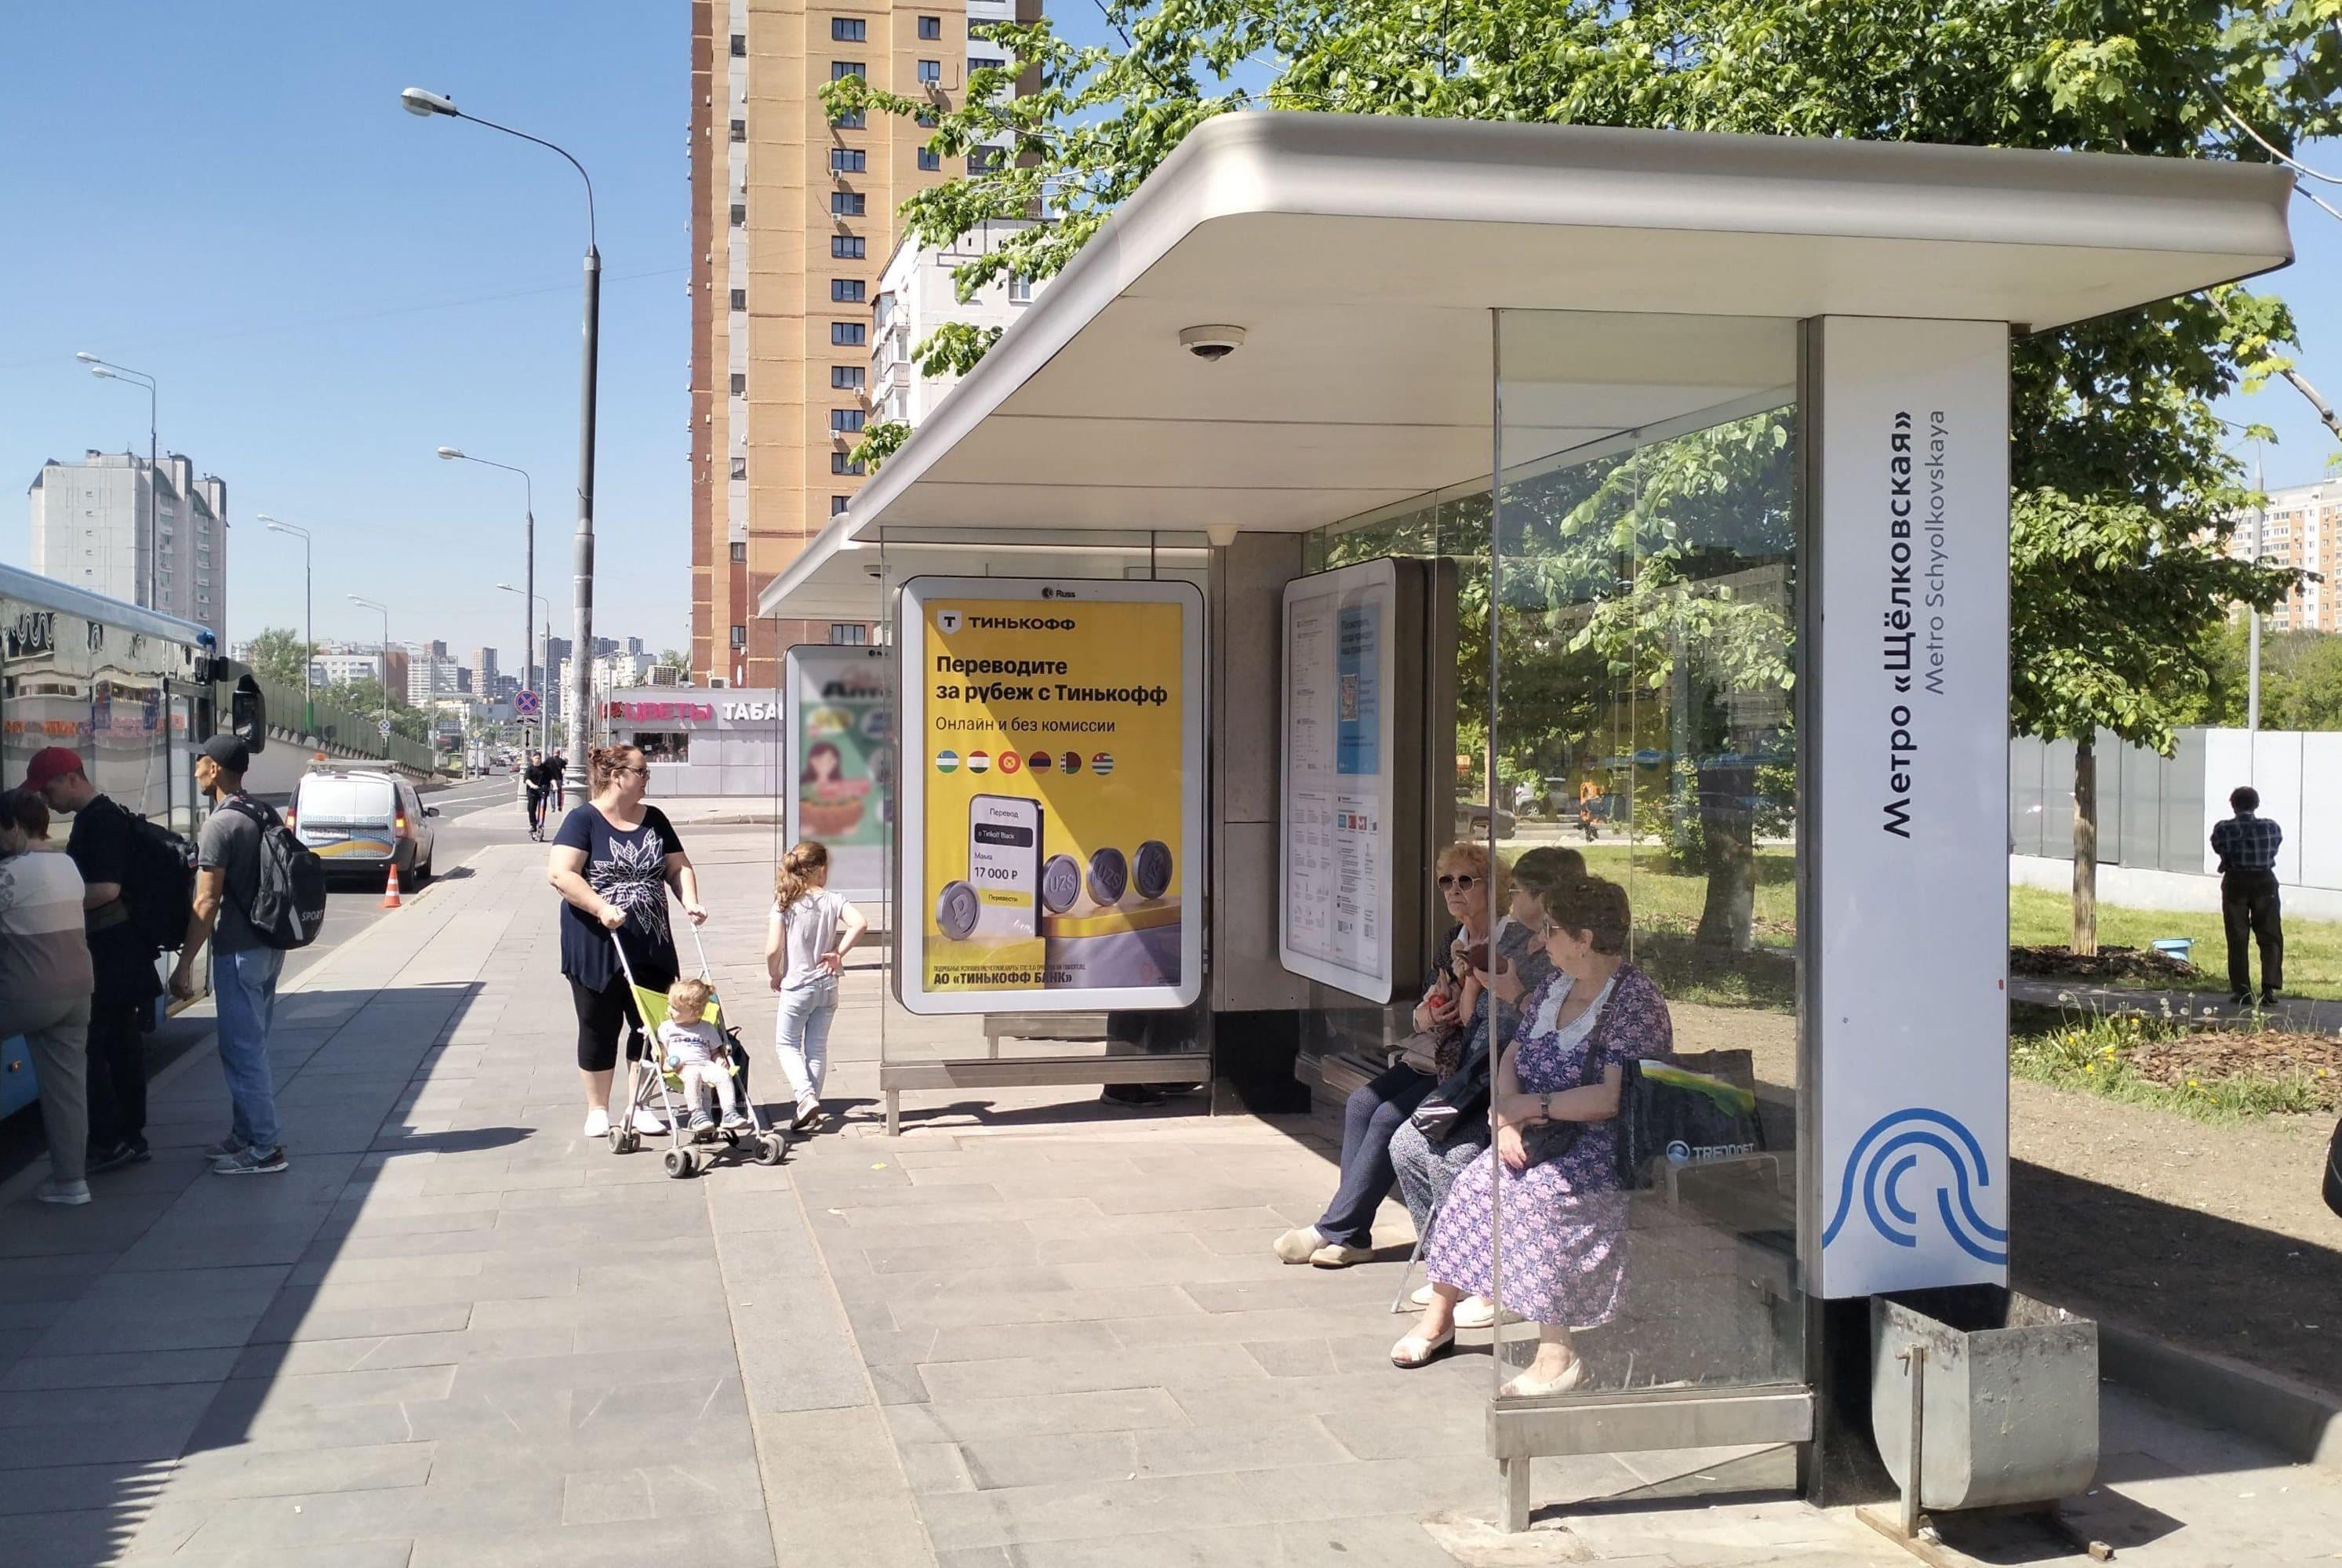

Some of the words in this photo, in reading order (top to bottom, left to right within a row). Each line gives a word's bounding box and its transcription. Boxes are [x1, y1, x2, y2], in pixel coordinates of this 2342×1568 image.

[1924, 410, 1948, 608] Schyolkovskaya
[1884, 410, 1916, 693] «Щёлковская»
[1056, 589, 1076, 598] Russ
[968, 617, 1076, 631] ТИНЬКОФФ
[1925, 616, 1944, 695] Metro
[936, 656, 1067, 677] Переводите
[936, 685, 960, 700] за
[965, 682, 1034, 704] рубеж
[1038, 686, 1051, 700] с
[1054, 683, 1168, 706] Тинькофф
[624, 701, 712, 723] ЦВЕТЫ
[936, 716, 994, 731] Онлайн
[998, 719, 1007, 731] и
[1011, 717, 1038, 732] без
[1042, 720, 1115, 733] комиссии
[1884, 705, 1917, 839] Метро
[989, 808, 1019, 818] Перевод
[974, 867, 986, 878] 17
[987, 868, 1009, 880] 000
[1049, 874, 1075, 891] UZS
[933, 973, 950, 985] АО
[954, 972, 1031, 984] «ТИНЬКОФФ
[1035, 972, 1072, 984] БАНК»
